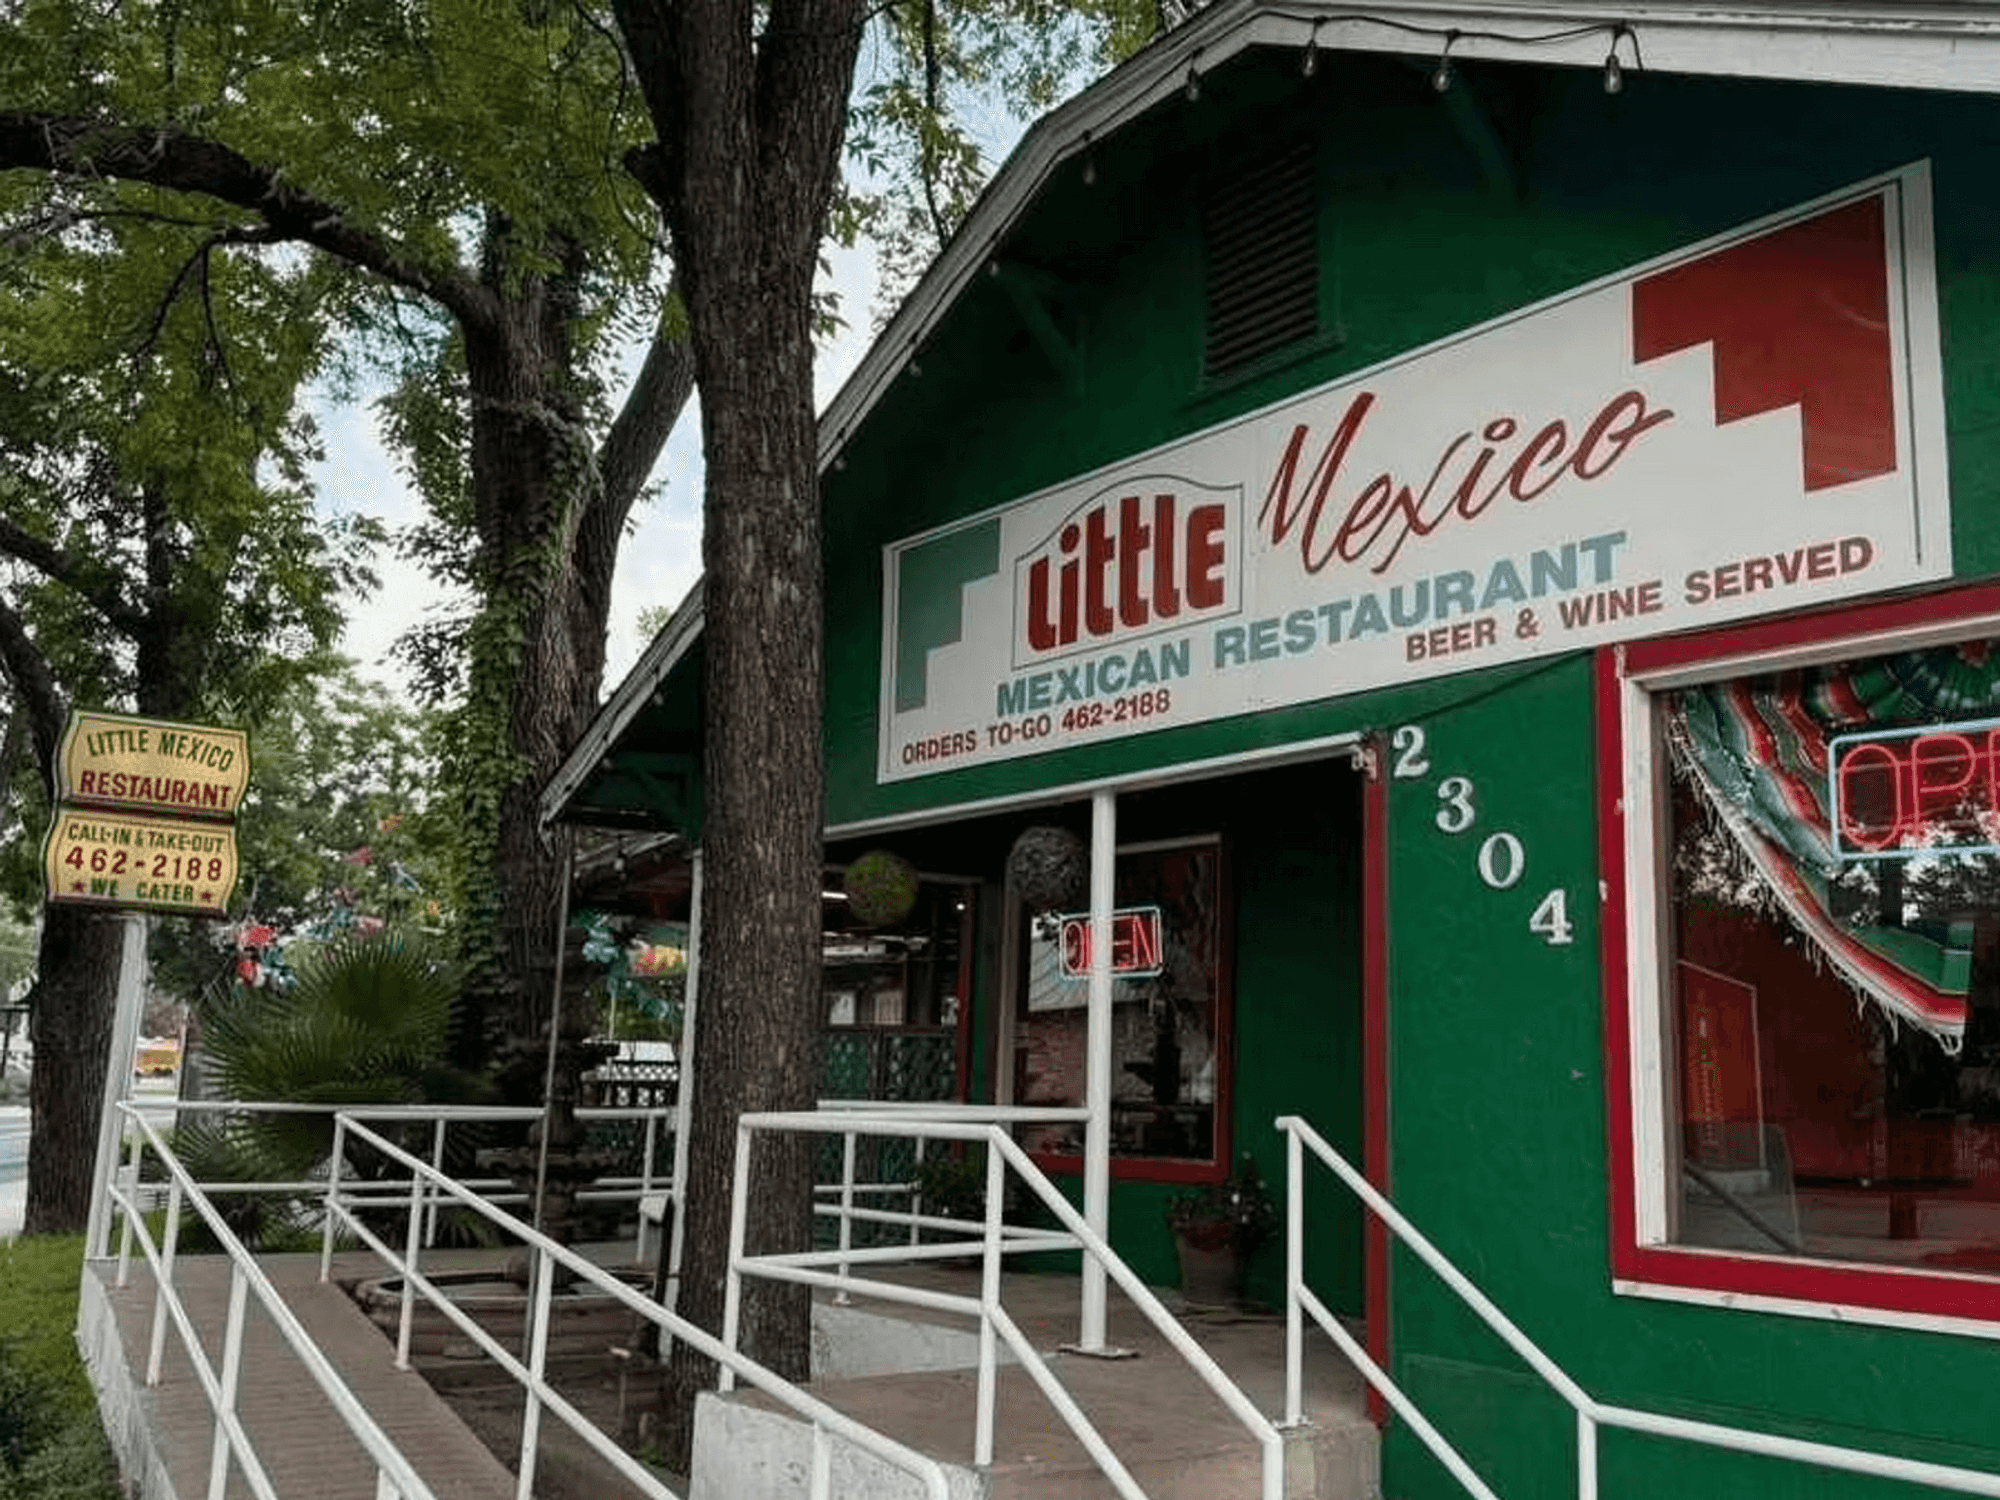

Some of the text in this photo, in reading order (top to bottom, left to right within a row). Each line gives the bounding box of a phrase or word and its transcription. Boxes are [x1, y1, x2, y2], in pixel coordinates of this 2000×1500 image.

[1258, 391, 1674, 575] Mexico
[996, 532, 1628, 718] MEXICAN RESTAURANT
[1406, 536, 1875, 662] BEER & WINE SERVED
[87, 729, 234, 771] LITTLE MEXICO
[902, 689, 1171, 766] ORDERS TO-GO 462-2188
[80, 770, 232, 807] RESTAURANT
[1839, 726, 2000, 852] OP
[65, 846, 223, 882] 462-2188
[90, 878, 193, 902] WE CATER
[1064, 914, 1157, 976] OEN
